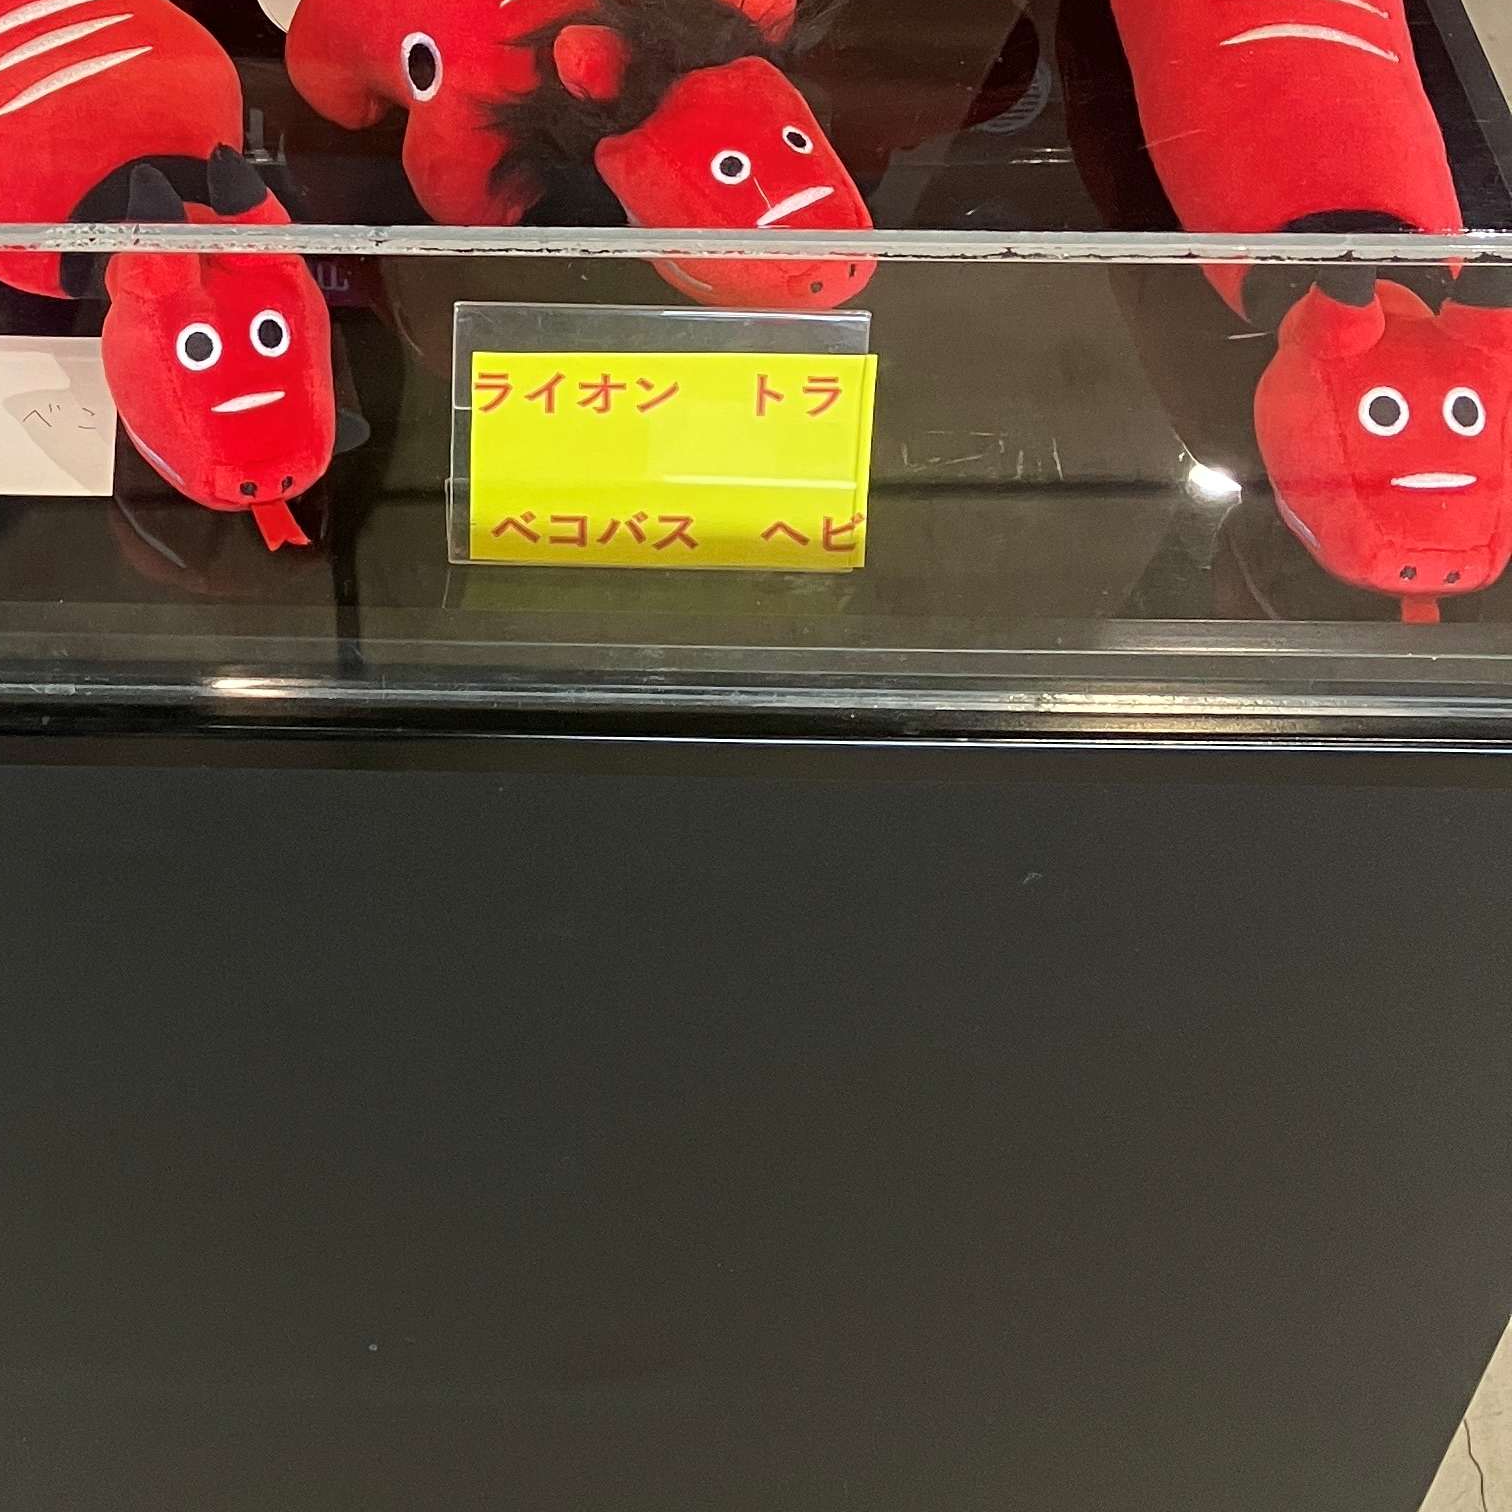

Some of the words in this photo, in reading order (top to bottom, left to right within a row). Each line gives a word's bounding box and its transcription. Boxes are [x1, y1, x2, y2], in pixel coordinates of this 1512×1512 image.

[472, 372, 679, 415] ライオン
[751, 372, 844, 417] トラ
